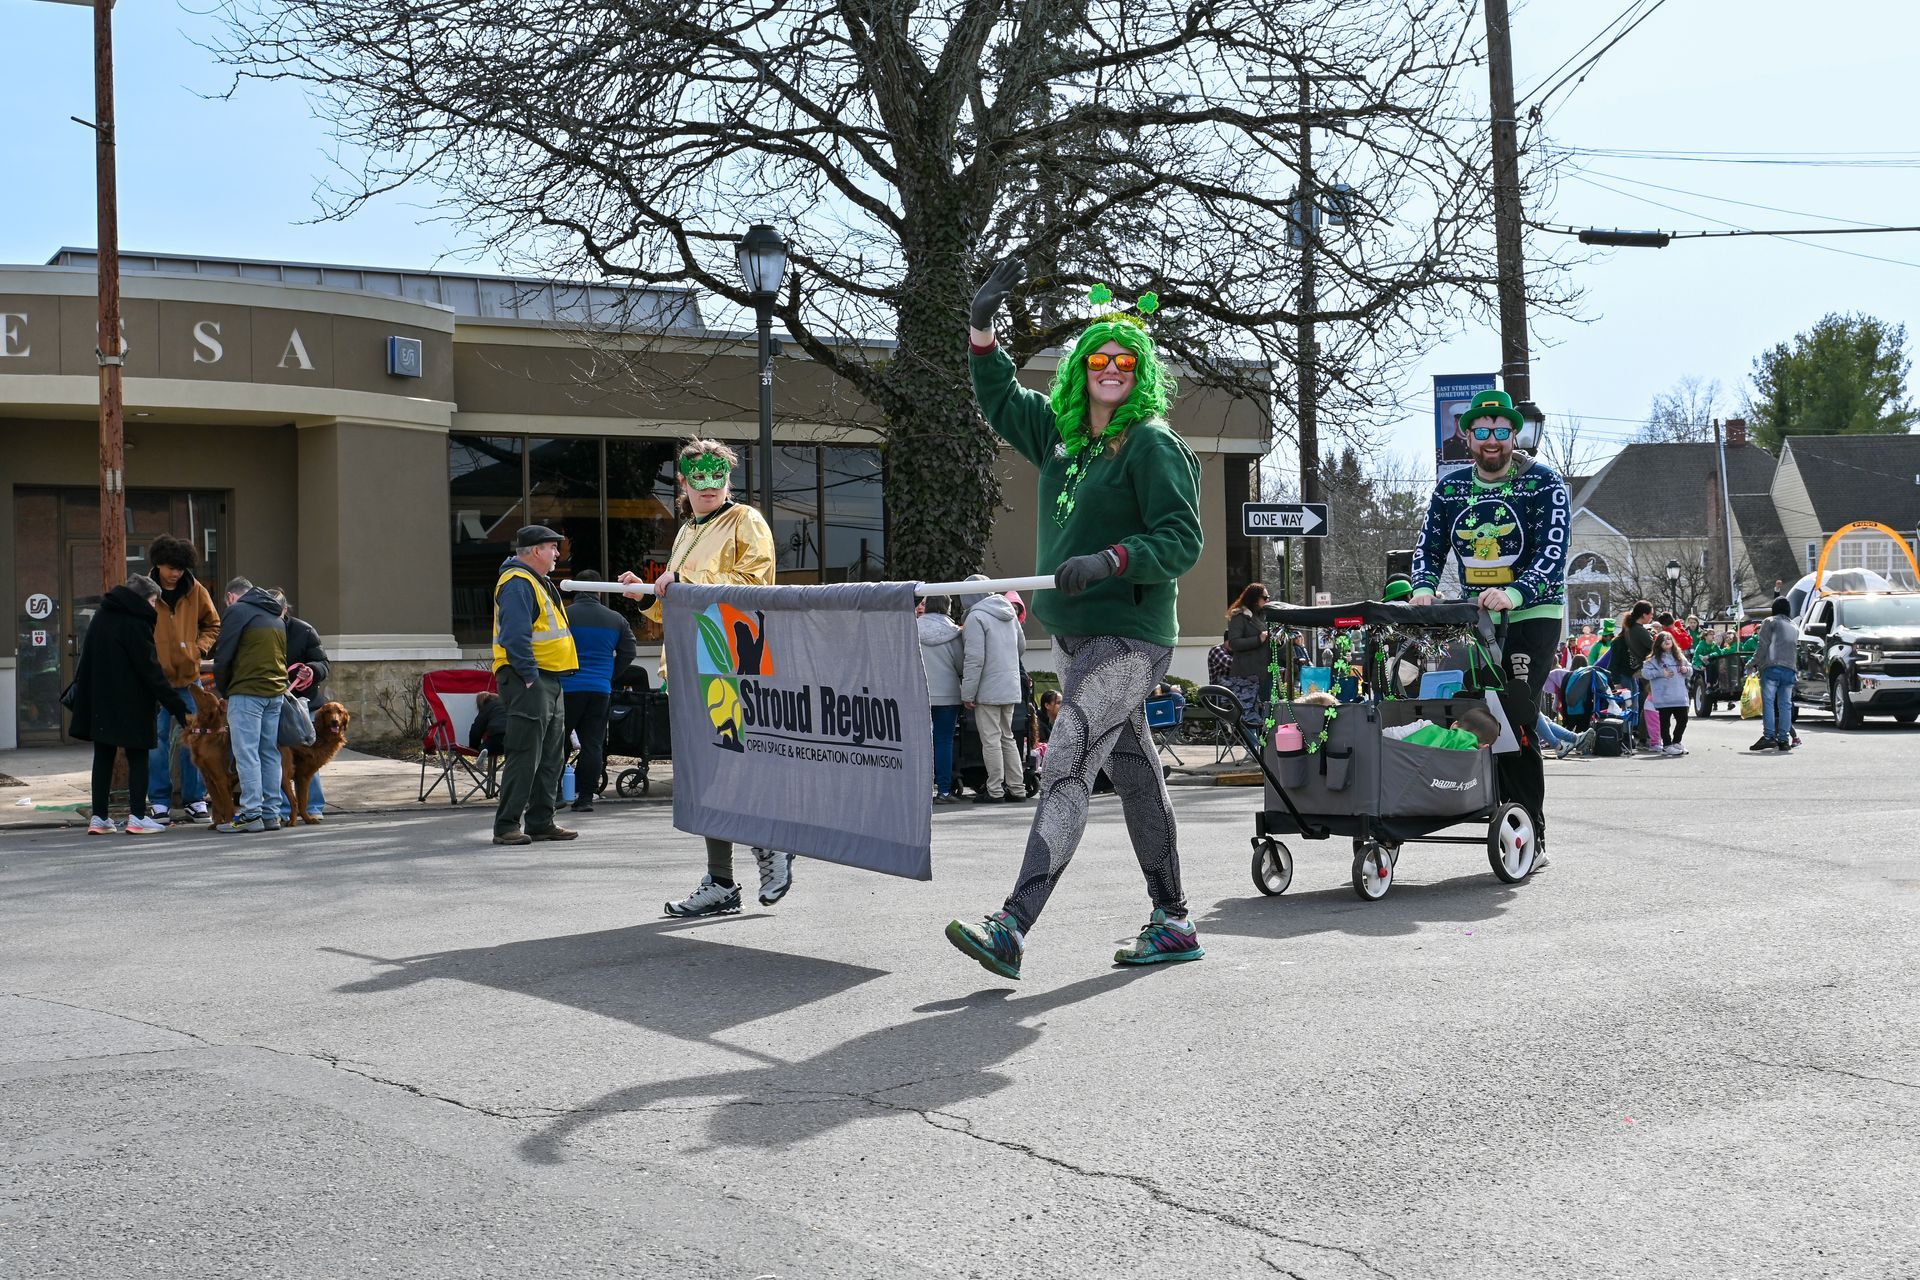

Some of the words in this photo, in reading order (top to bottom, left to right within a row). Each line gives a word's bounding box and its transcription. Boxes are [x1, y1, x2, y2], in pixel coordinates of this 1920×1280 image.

[0, 312, 316, 370] ESA
[1253, 513, 1278, 526] ONE
[1280, 513, 1304, 526] WAY
[1411, 501, 1432, 573] ROGU
[1533, 488, 1567, 574] GROGU
[739, 678, 813, 734] Stroud
[819, 686, 902, 744] Region
[746, 739, 767, 753] OPEN
[767, 741, 787, 757] SPACE
[787, 745, 794, 758] &
[795, 747, 849, 764] RECREATION
[850, 752, 903, 770] COMMISSION
